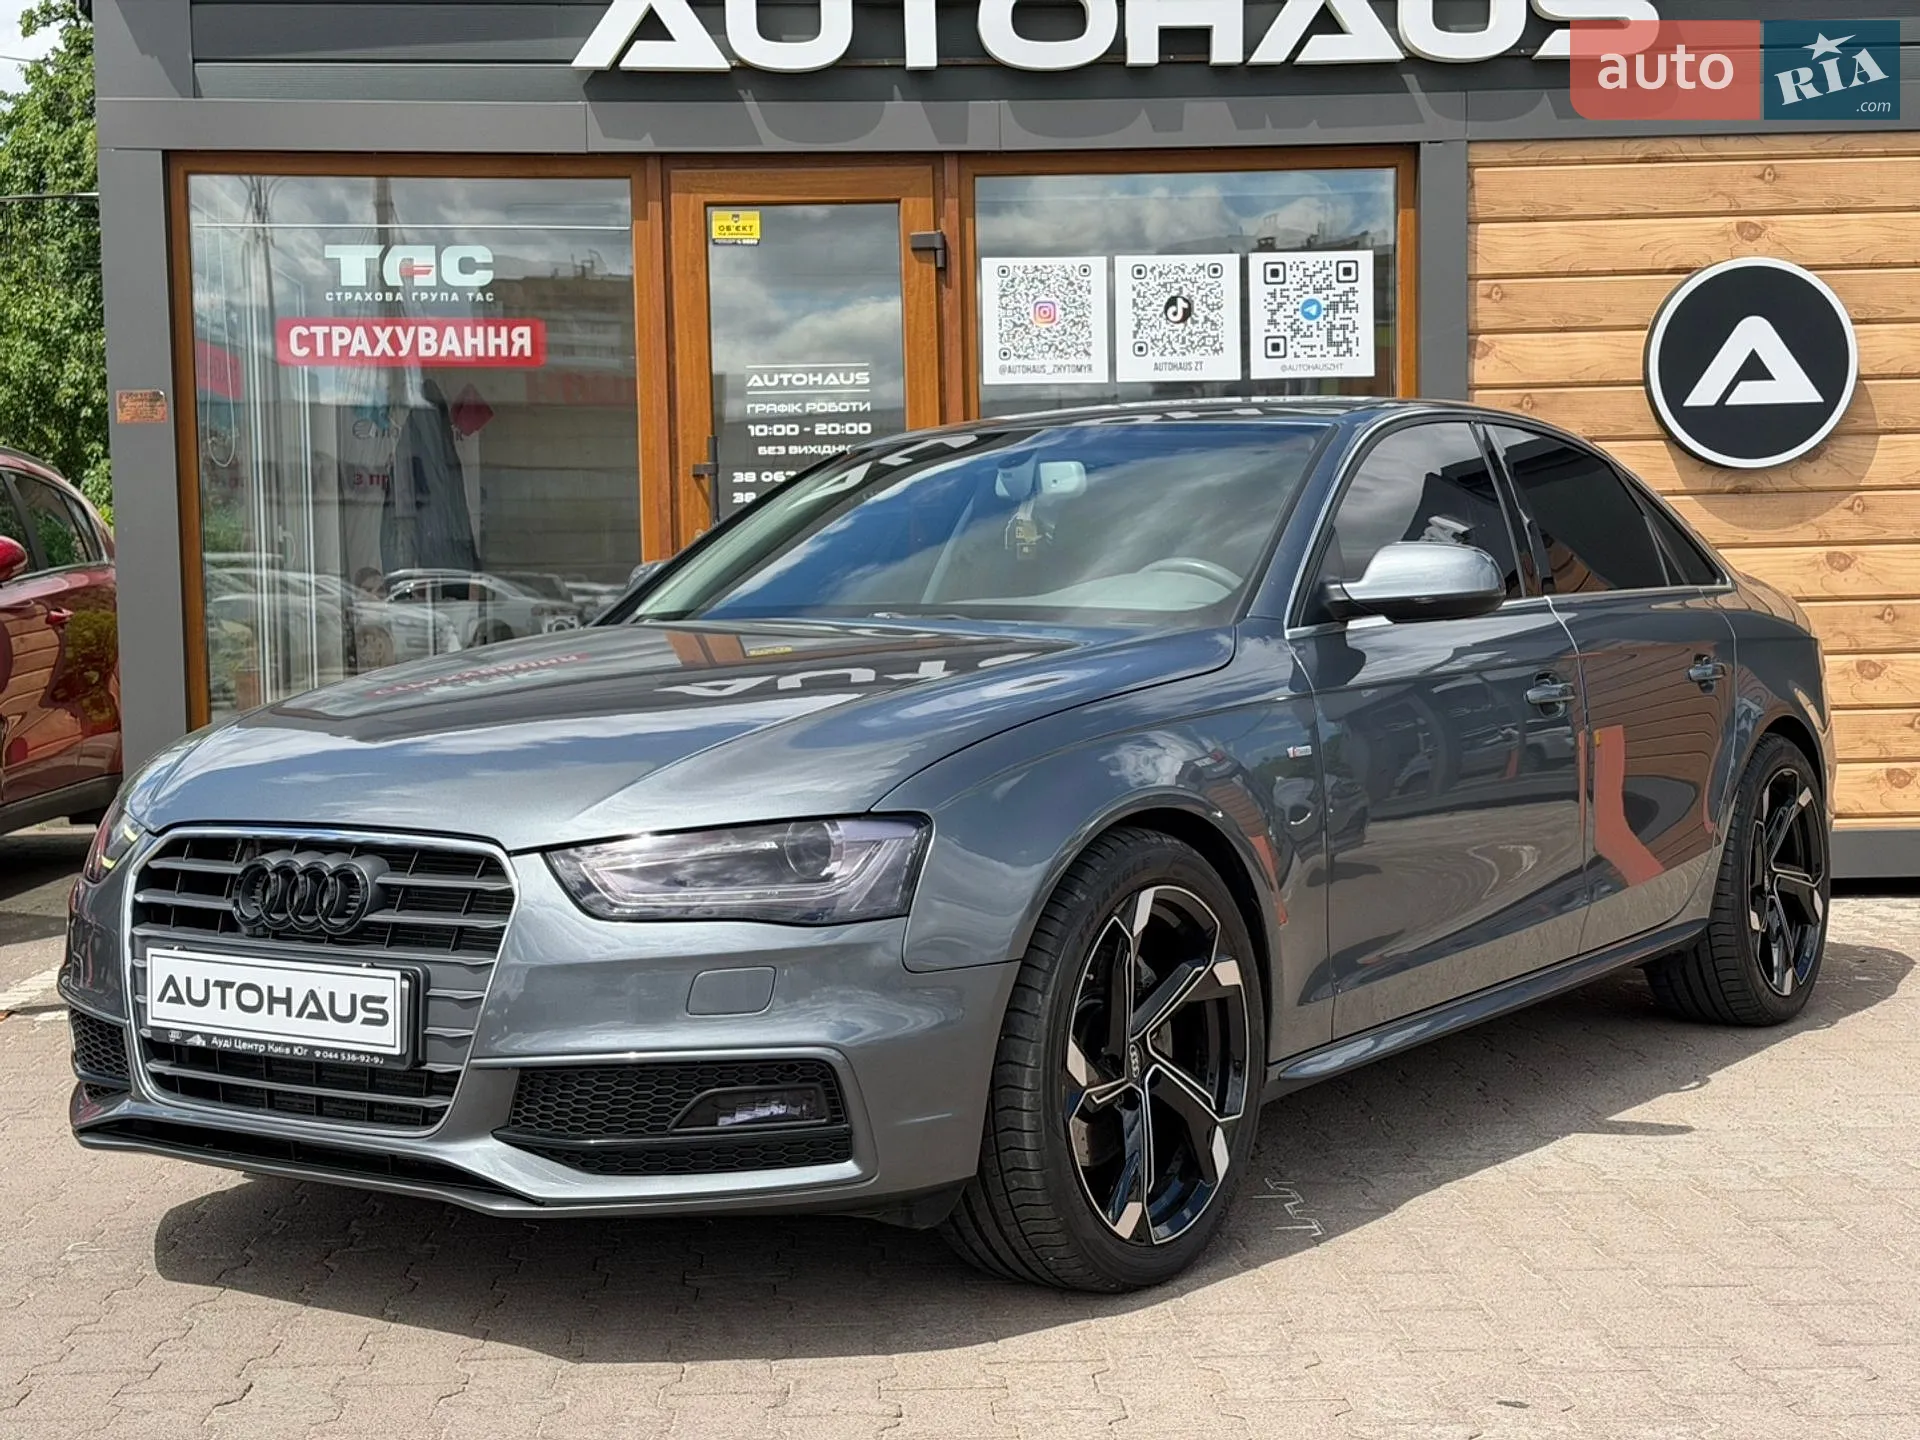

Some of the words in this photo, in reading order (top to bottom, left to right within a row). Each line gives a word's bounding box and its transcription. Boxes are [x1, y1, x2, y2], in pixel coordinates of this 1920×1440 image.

[325, 292, 404, 302] СТРАХОВА
[412, 292, 460, 302] ГРУПА
[467, 291, 495, 302] ТАС
[289, 325, 533, 358] СТРАХУВАННЯ
[1153, 361, 1194, 372] AUTOHAUS
[746, 371, 870, 388] AUTOHAUS
[747, 402, 802, 414] ГРАФІК
[805, 401, 871, 413] РОБОТИ
[747, 423, 800, 437] 10:00
[814, 422, 872, 435] 20:00
[758, 446, 786, 455] БЕЗ
[732, 471, 757, 483] 38
[157, 973, 390, 1028] AUTOHAUS
[234, 1039, 265, 1053] Центр
